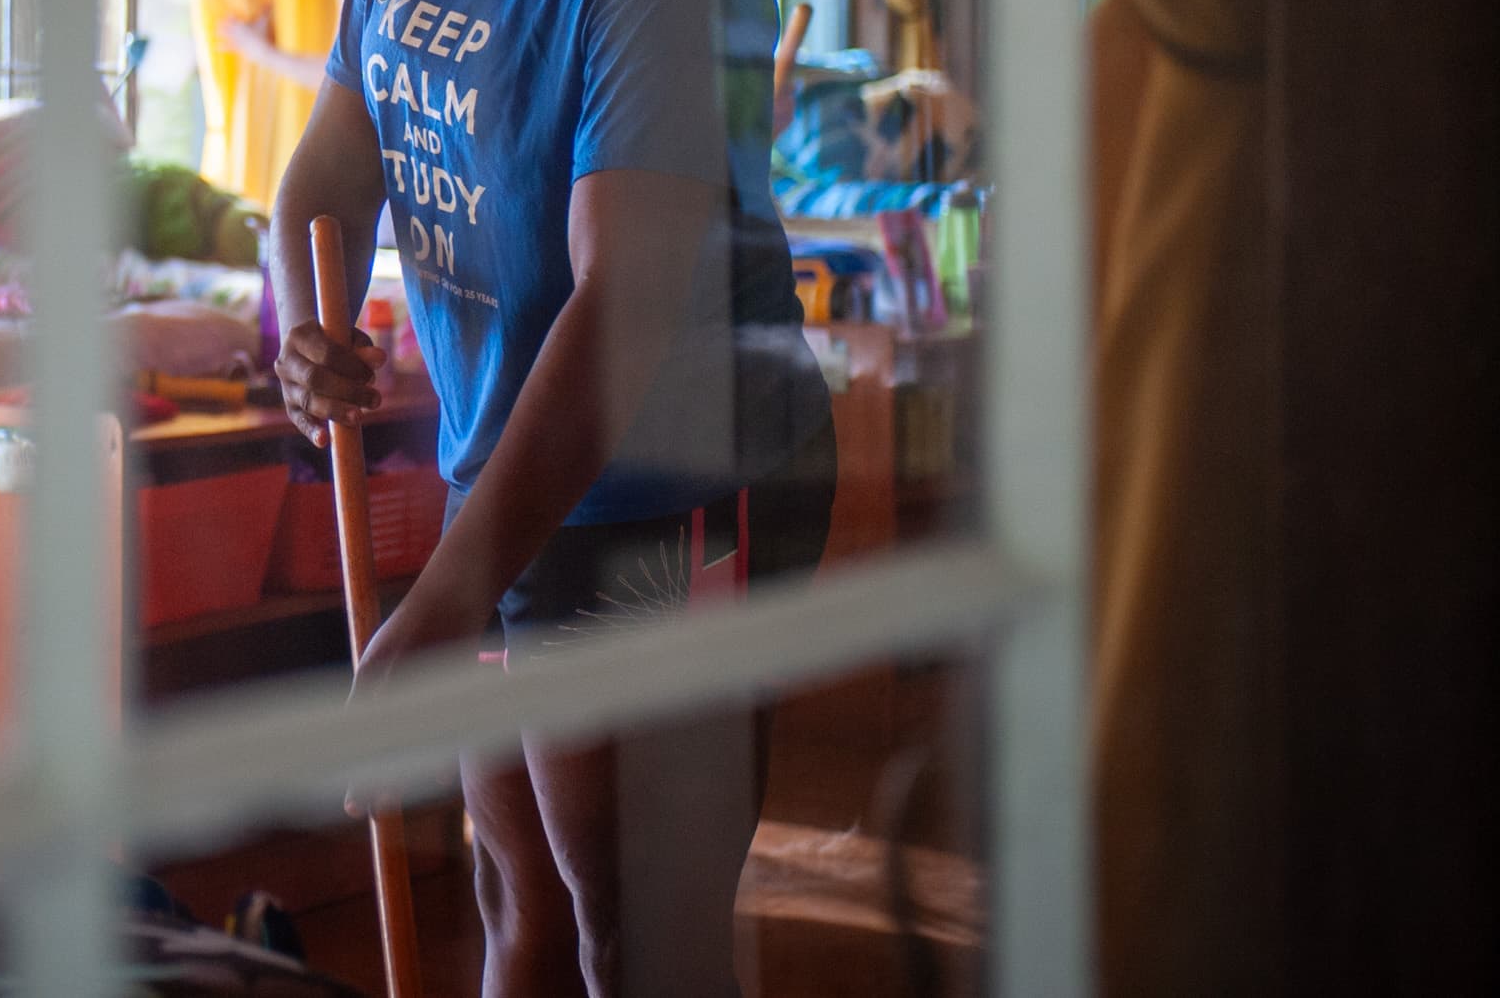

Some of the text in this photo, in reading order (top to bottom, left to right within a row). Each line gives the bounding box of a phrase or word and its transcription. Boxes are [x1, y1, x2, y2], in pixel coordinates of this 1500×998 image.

[366, 53, 478, 134] CALM
[403, 122, 441, 155] AND
[382, 149, 486, 225] TUDY
[410, 215, 454, 275] ON
[465, 290, 475, 300] 25
[476, 292, 498, 309] YEARS
